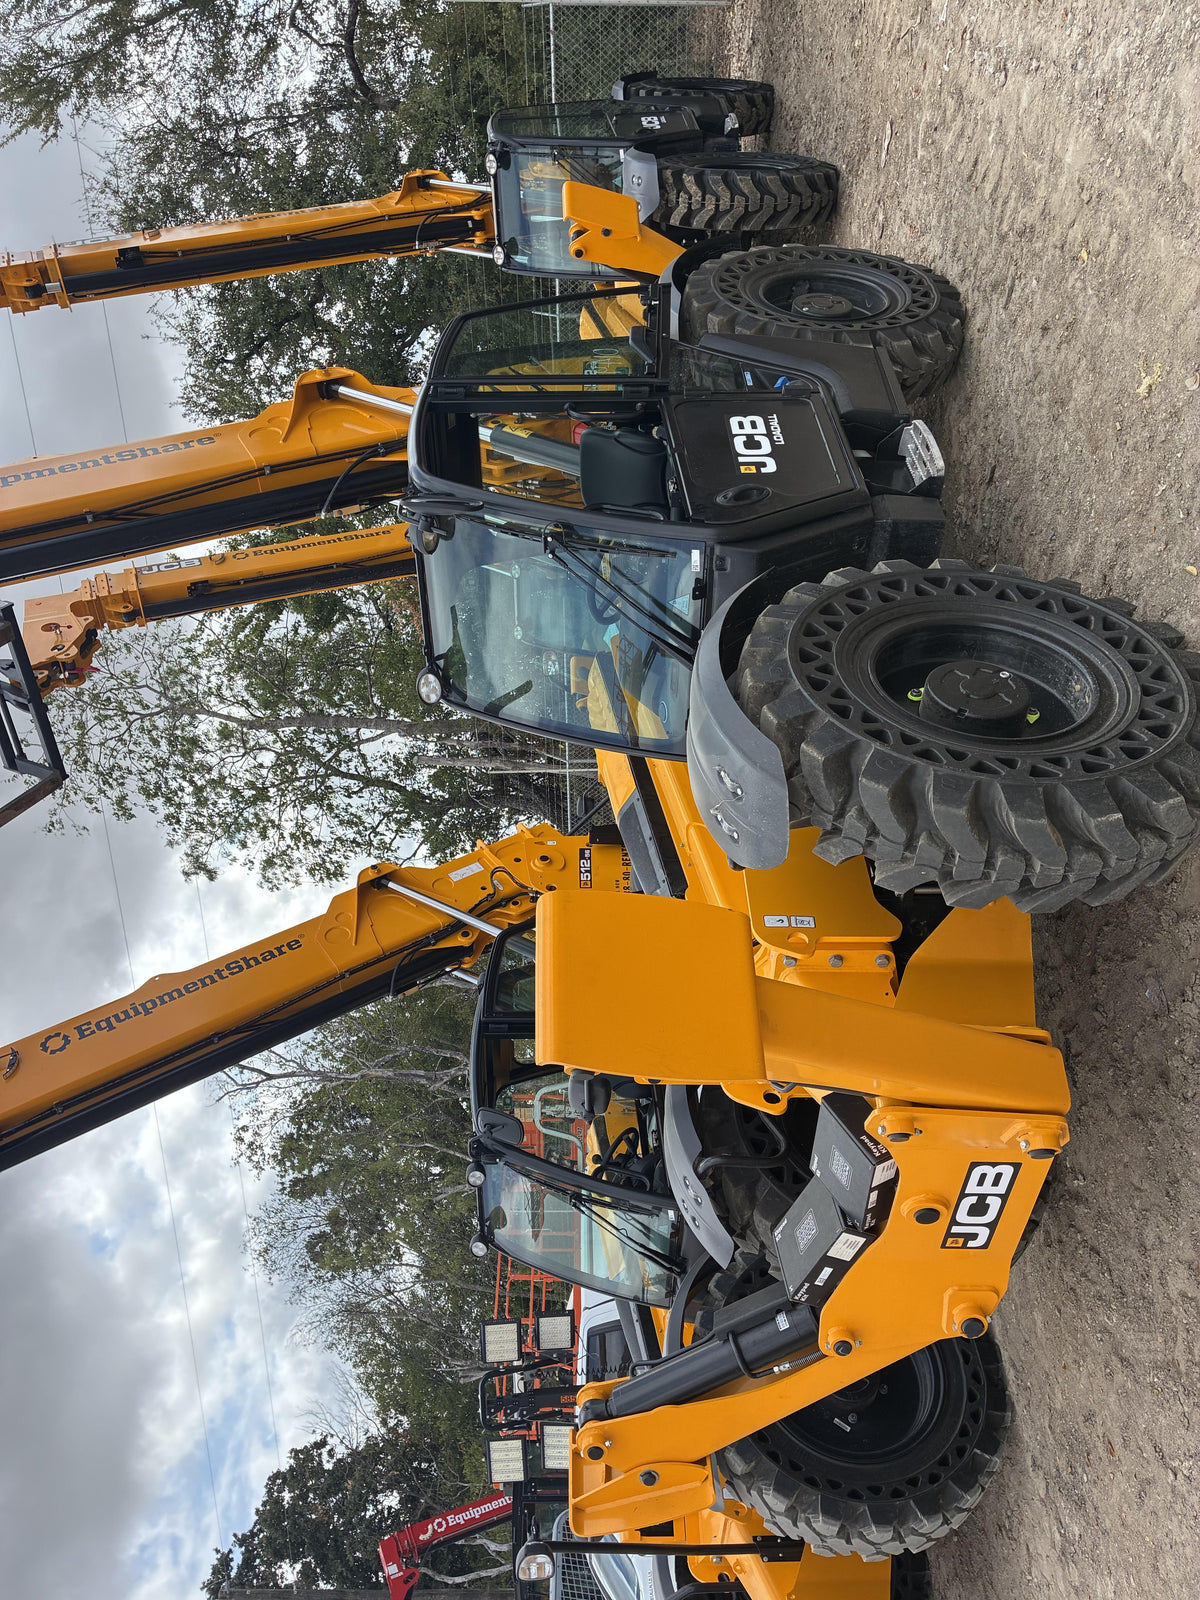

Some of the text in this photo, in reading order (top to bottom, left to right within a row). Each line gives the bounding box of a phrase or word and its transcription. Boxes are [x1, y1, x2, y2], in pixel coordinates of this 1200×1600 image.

[641, 116, 661, 130] JCB
[768, 414, 785, 445] LOADALL
[729, 415, 777, 473] JCB
[252, 530, 392, 556] EquipmentShare
[140, 558, 201, 574] JCB
[73, 938, 303, 1040] EquipmentShare
[860, 1134, 881, 1157] Keypad
[951, 1165, 1014, 1247] JCB
